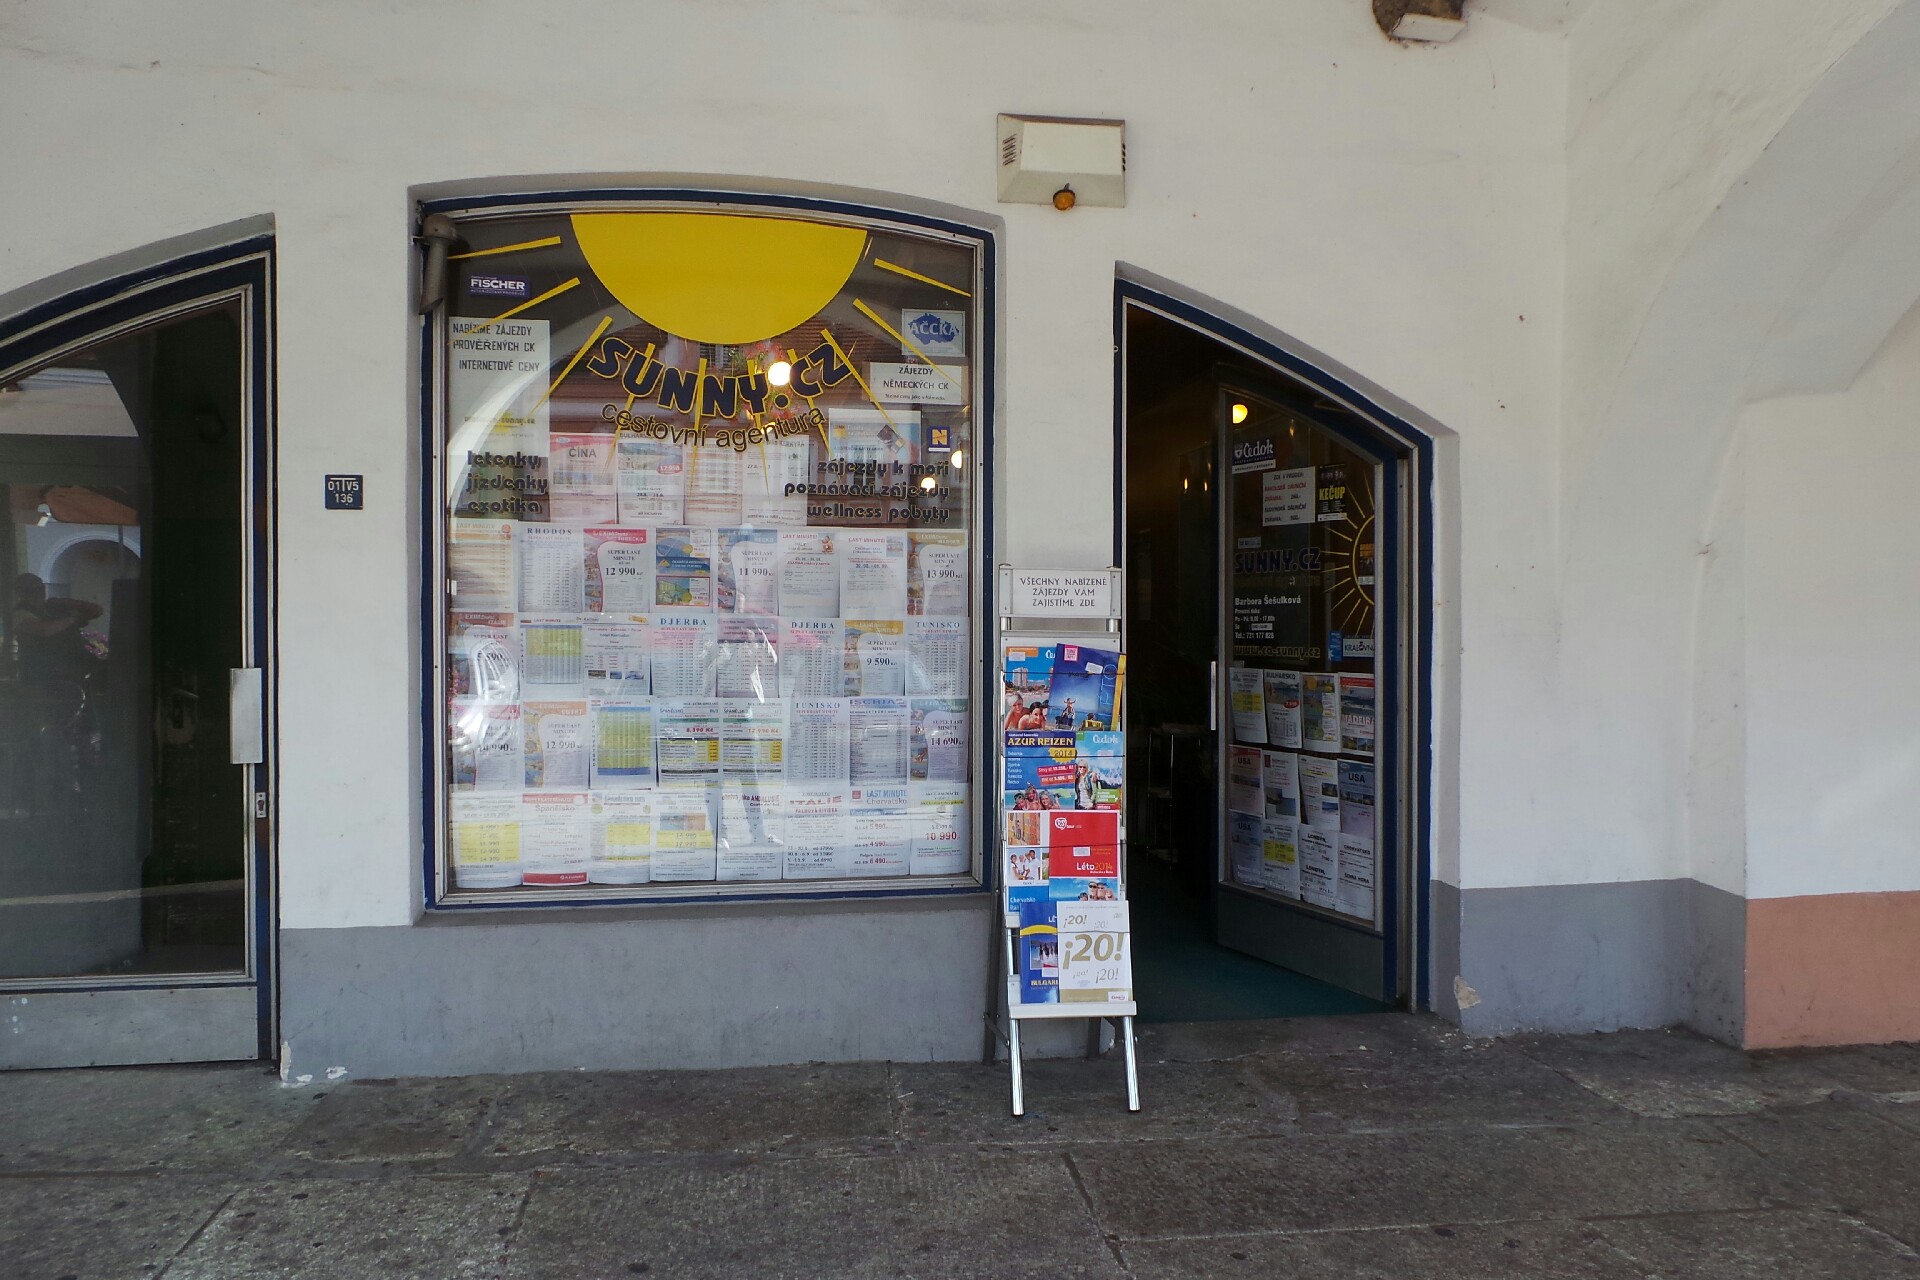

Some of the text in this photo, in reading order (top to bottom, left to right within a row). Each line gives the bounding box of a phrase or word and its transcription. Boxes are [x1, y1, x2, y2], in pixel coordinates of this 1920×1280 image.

[471, 278, 525, 290] FISCHER
[496, 324, 532, 336] ZÁJEZDY
[452, 338, 535, 352] PROVĚŘENÝCH CK
[458, 360, 540, 372] INTERNETOVÉ CENY
[898, 365, 934, 376] ZÁJEZDY
[586, 336, 852, 418] SUNNY.CZ
[883, 379, 949, 390] NĚMECKÝCH CK
[602, 404, 826, 452] cestovní agentura
[568, 447, 597, 458] ČÍNA
[817, 457, 949, 478] zájezdy k moři
[784, 480, 949, 501] poznávací zájezdy
[1319, 486, 1346, 500] KEČUP
[335, 494, 353, 503] 136
[467, 497, 541, 513] exotika
[807, 503, 949, 524] wellness pobyty
[527, 527, 572, 535] RHODOS
[1233, 547, 1321, 573] SUNNY.CZ
[604, 568, 636, 576] 12 990
[752, 568, 768, 576] 990
[927, 570, 955, 578] 13 990
[1020, 576, 1107, 586] VŠECHNY NABÍZENÉ
[1032, 588, 1095, 597] ZÁJEZDY VÁM
[1032, 598, 1074, 608] ZAJISTÍME
[1235, 597, 1262, 606] Barbora
[660, 618, 707, 626] DJERBA
[874, 658, 890, 666] 590
[546, 741, 576, 749] 12 990
[930, 738, 958, 746] 14 690
[1008, 738, 1073, 746] AZUR REIZEN
[1238, 757, 1250, 765] USA
[1348, 773, 1365, 784] USA
[1238, 823, 1252, 832] USA
